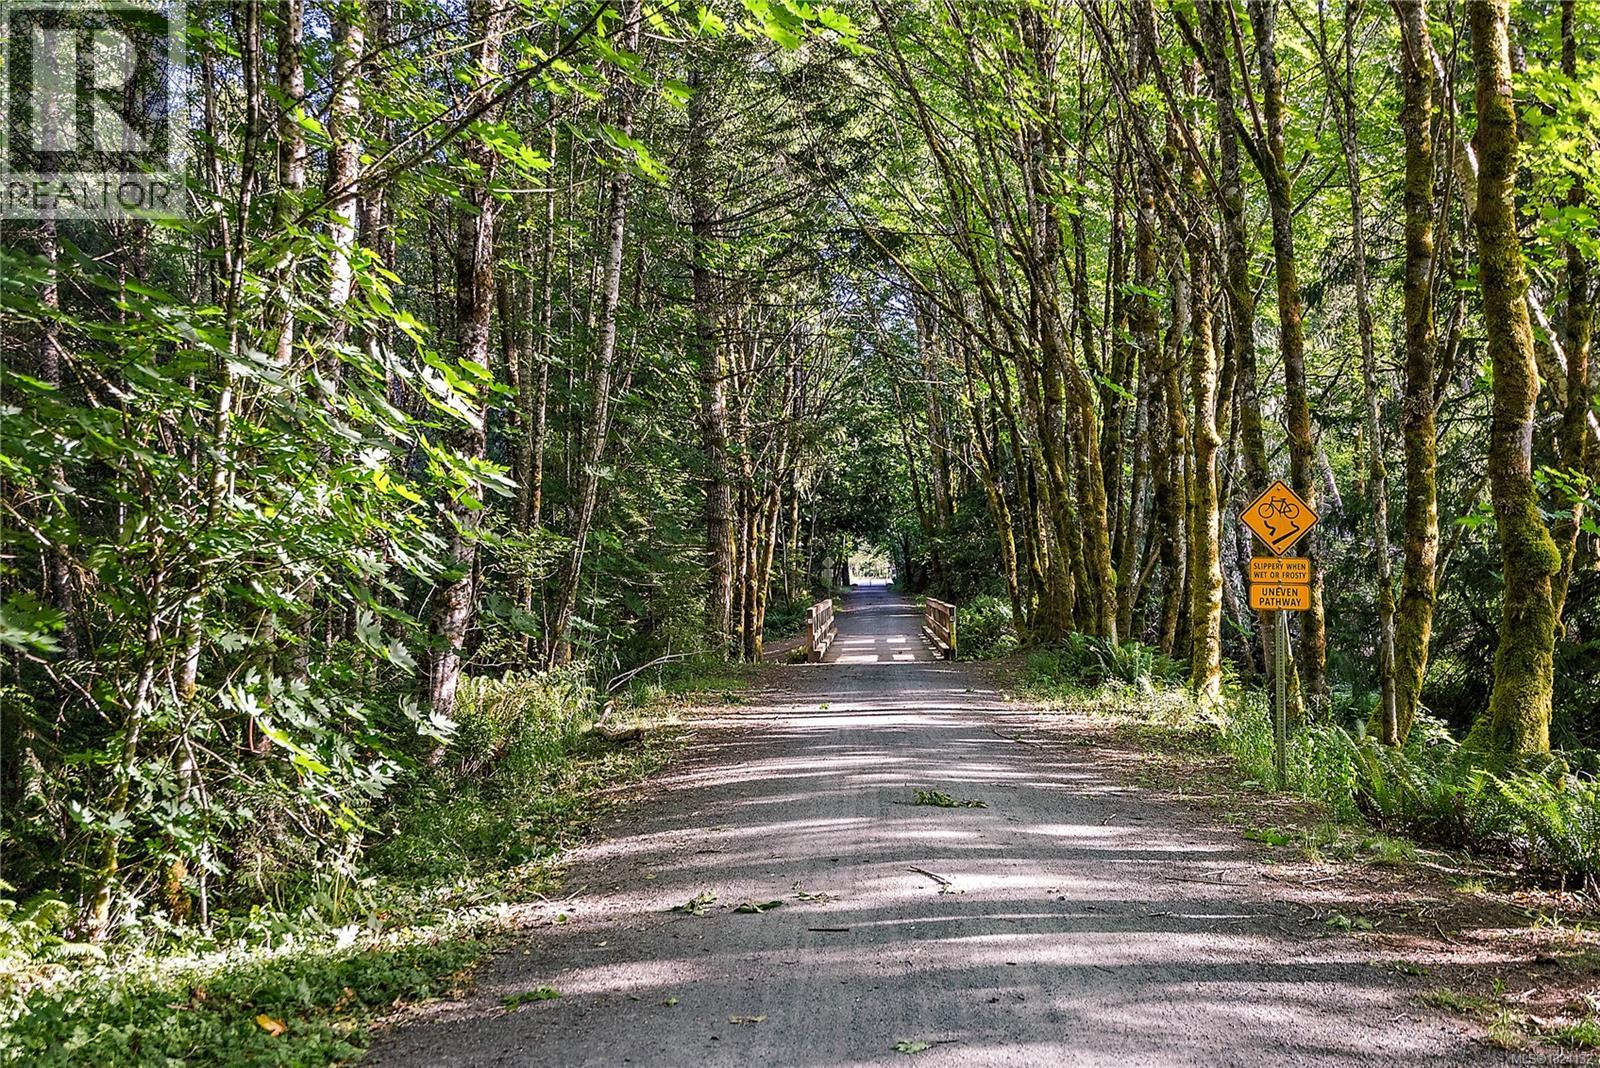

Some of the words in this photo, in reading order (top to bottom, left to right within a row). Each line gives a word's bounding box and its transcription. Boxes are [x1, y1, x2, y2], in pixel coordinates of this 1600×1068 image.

[1254, 571, 1267, 579] WET
[1269, 571, 1280, 579] OR
[1282, 571, 1306, 579] FROSTY
[1262, 588, 1298, 597] UNEVEN
[1259, 597, 1301, 607] PATHWAY
